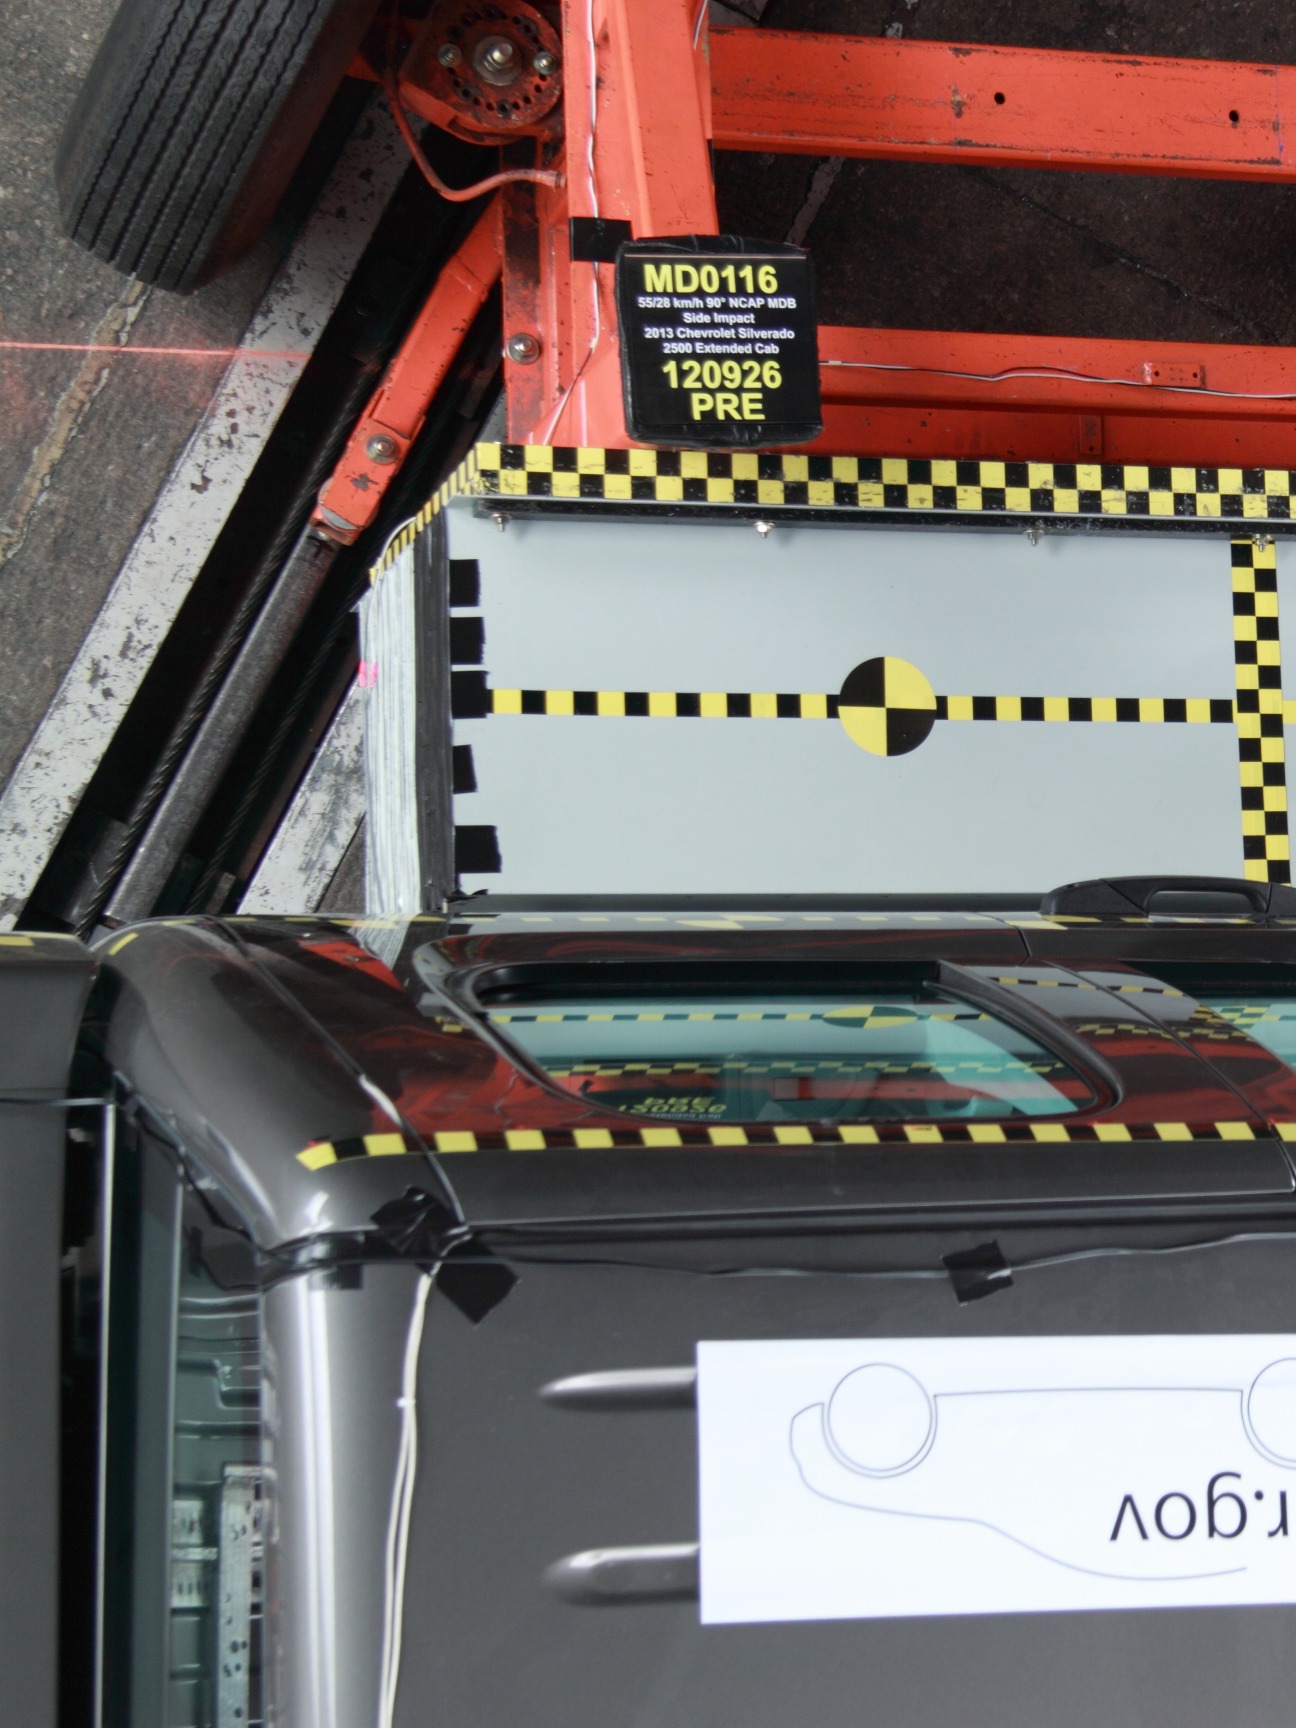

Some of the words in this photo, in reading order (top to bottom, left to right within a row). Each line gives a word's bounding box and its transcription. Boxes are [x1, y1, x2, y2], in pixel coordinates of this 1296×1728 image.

[643, 264, 778, 294] MD0116
[638, 296, 671, 309] 55/28
[673, 296, 704, 309] km/h
[706, 297, 726, 309] 90°
[729, 297, 765, 309] NCAP
[767, 298, 797, 309] MDB
[683, 312, 712, 323] Side
[713, 312, 756, 325] Impact
[644, 327, 674, 339] 2013
[676, 327, 736, 339] Chevrolet
[738, 327, 795, 339] Silverado
[663, 342, 693, 354] 2500
[695, 342, 752, 354] Extended
[755, 342, 780, 354] Cab
[662, 360, 782, 389] 120926
[691, 393, 766, 420] PRE
